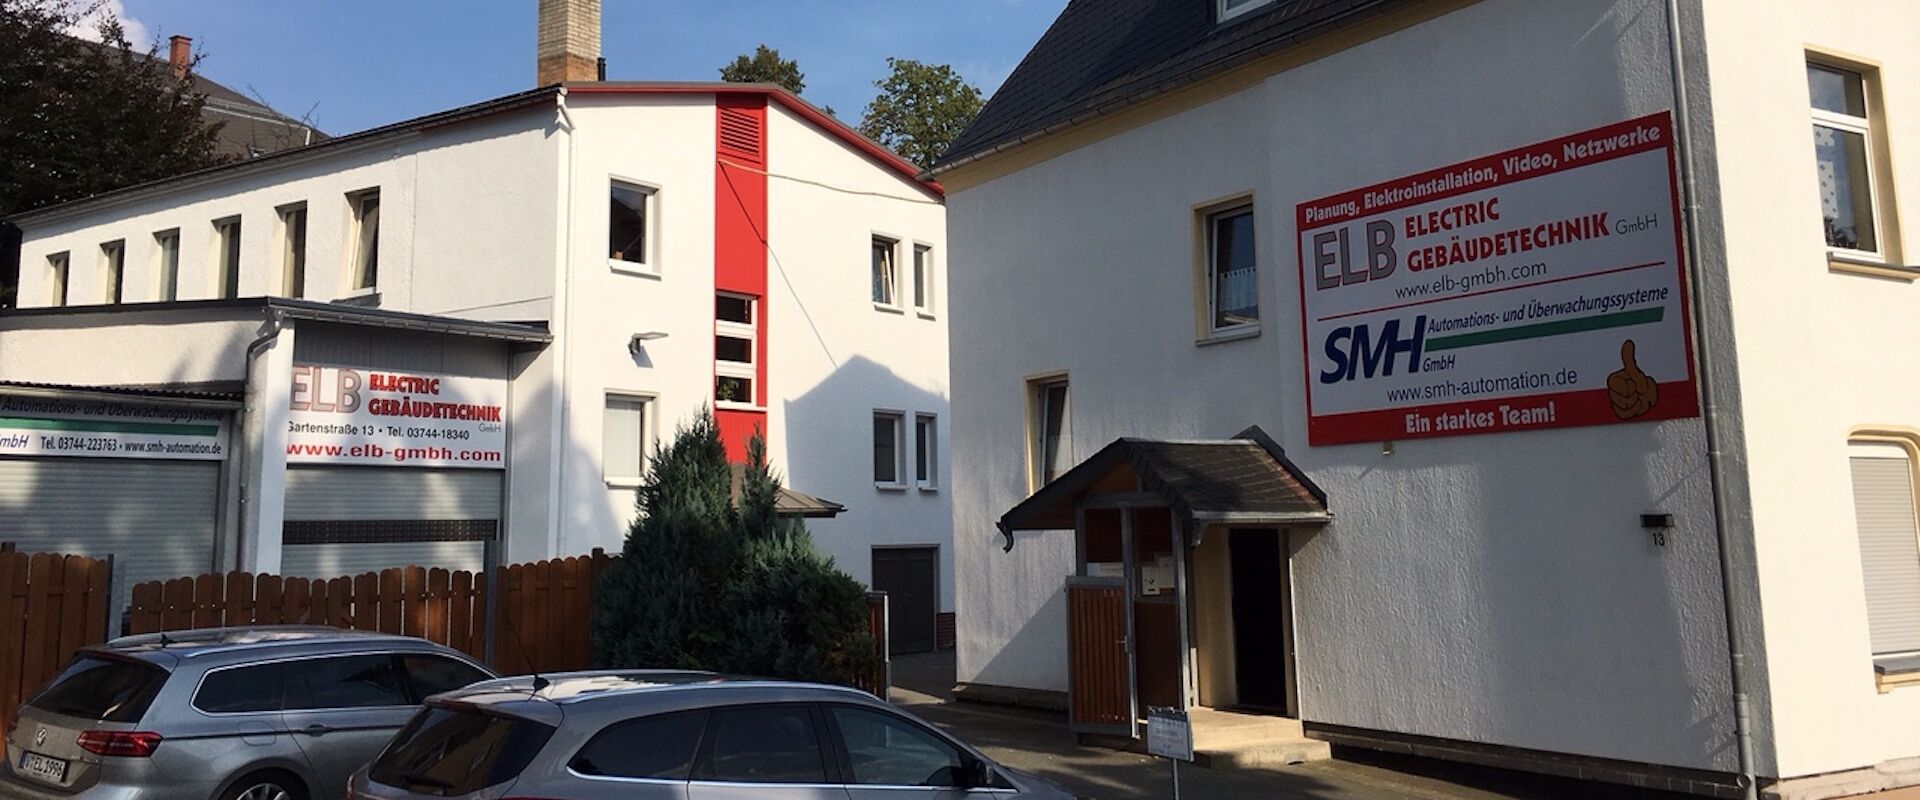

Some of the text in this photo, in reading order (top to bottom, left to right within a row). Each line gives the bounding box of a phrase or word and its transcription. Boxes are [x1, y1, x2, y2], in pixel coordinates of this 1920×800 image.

[1305, 125, 1660, 224] Planung, Elektroinstallation, Video, Netzwerke
[1405, 197, 1500, 239] ELECTRIC
[1313, 219, 1397, 290] ELB
[1407, 212, 1658, 272] GEBÄUDETECHNIK GmbH
[1395, 262, 1547, 299] www.elb-gmbh.com
[1427, 286, 1668, 334] Automations- und Überwachungssysteme
[1320, 315, 1427, 385] SMH
[1423, 354, 1456, 373] GmbH
[290, 366, 361, 413] ELB
[369, 374, 440, 395] ELECTRIC
[1386, 367, 1578, 402] www.smh-automation.de
[84, 400, 106, 415] und
[368, 396, 501, 422] GEBÄUDETECHNIK
[1405, 401, 1556, 434] Ein starkes Team!
[0, 434, 221, 454] mbH Tel. 03744-223763 www.smh-automation.de
[362, 425, 374, 436] 13
[387, 426, 404, 438] Tel.
[407, 427, 470, 440] 03744-18340
[478, 422, 500, 433] GmbH
[287, 443, 501, 461] www.elb-gmbh.com
[1652, 533, 1665, 546] 13
